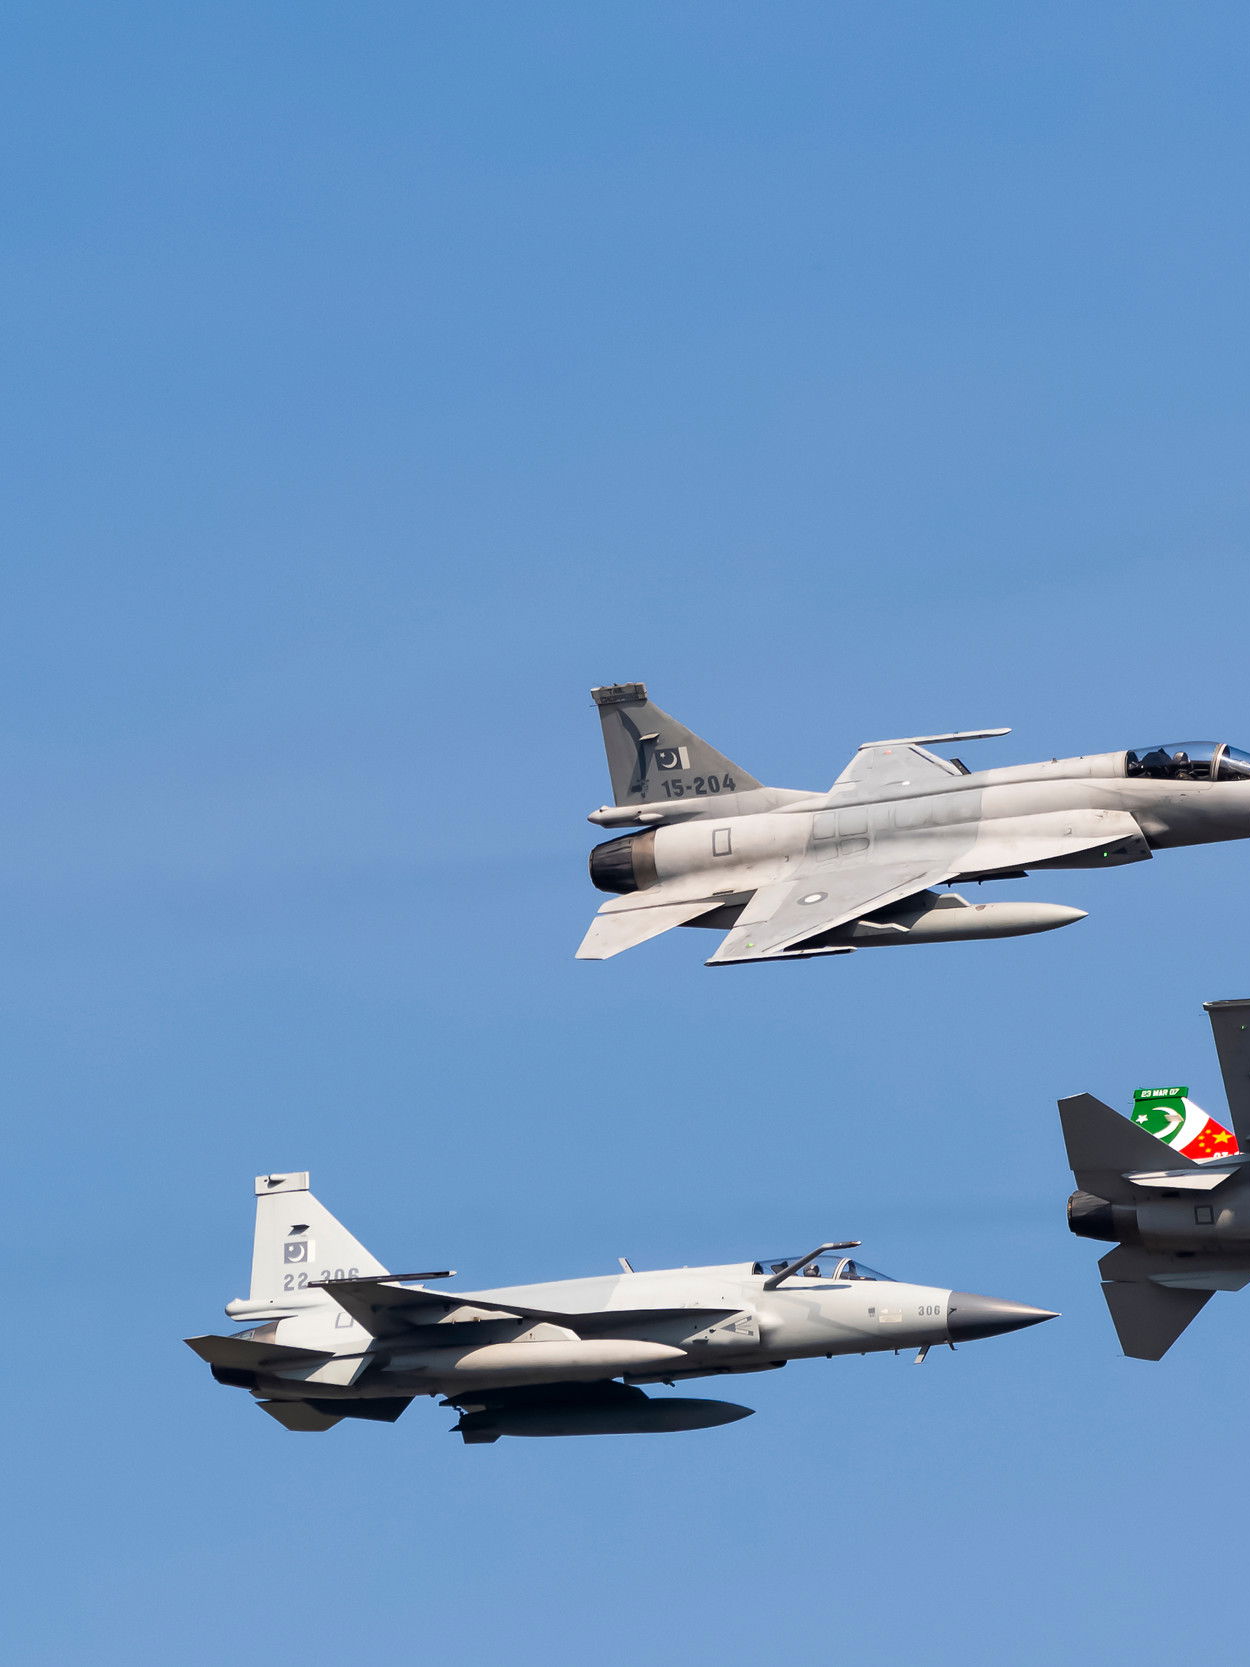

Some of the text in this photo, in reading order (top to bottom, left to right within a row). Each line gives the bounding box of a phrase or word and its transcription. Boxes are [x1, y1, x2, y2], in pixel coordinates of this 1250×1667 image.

[661, 773, 736, 798] 15-204
[1140, 1088, 1180, 1098] 23 MAR 07
[283, 1268, 360, 1291] 22306
[918, 1305, 941, 1316] 306
